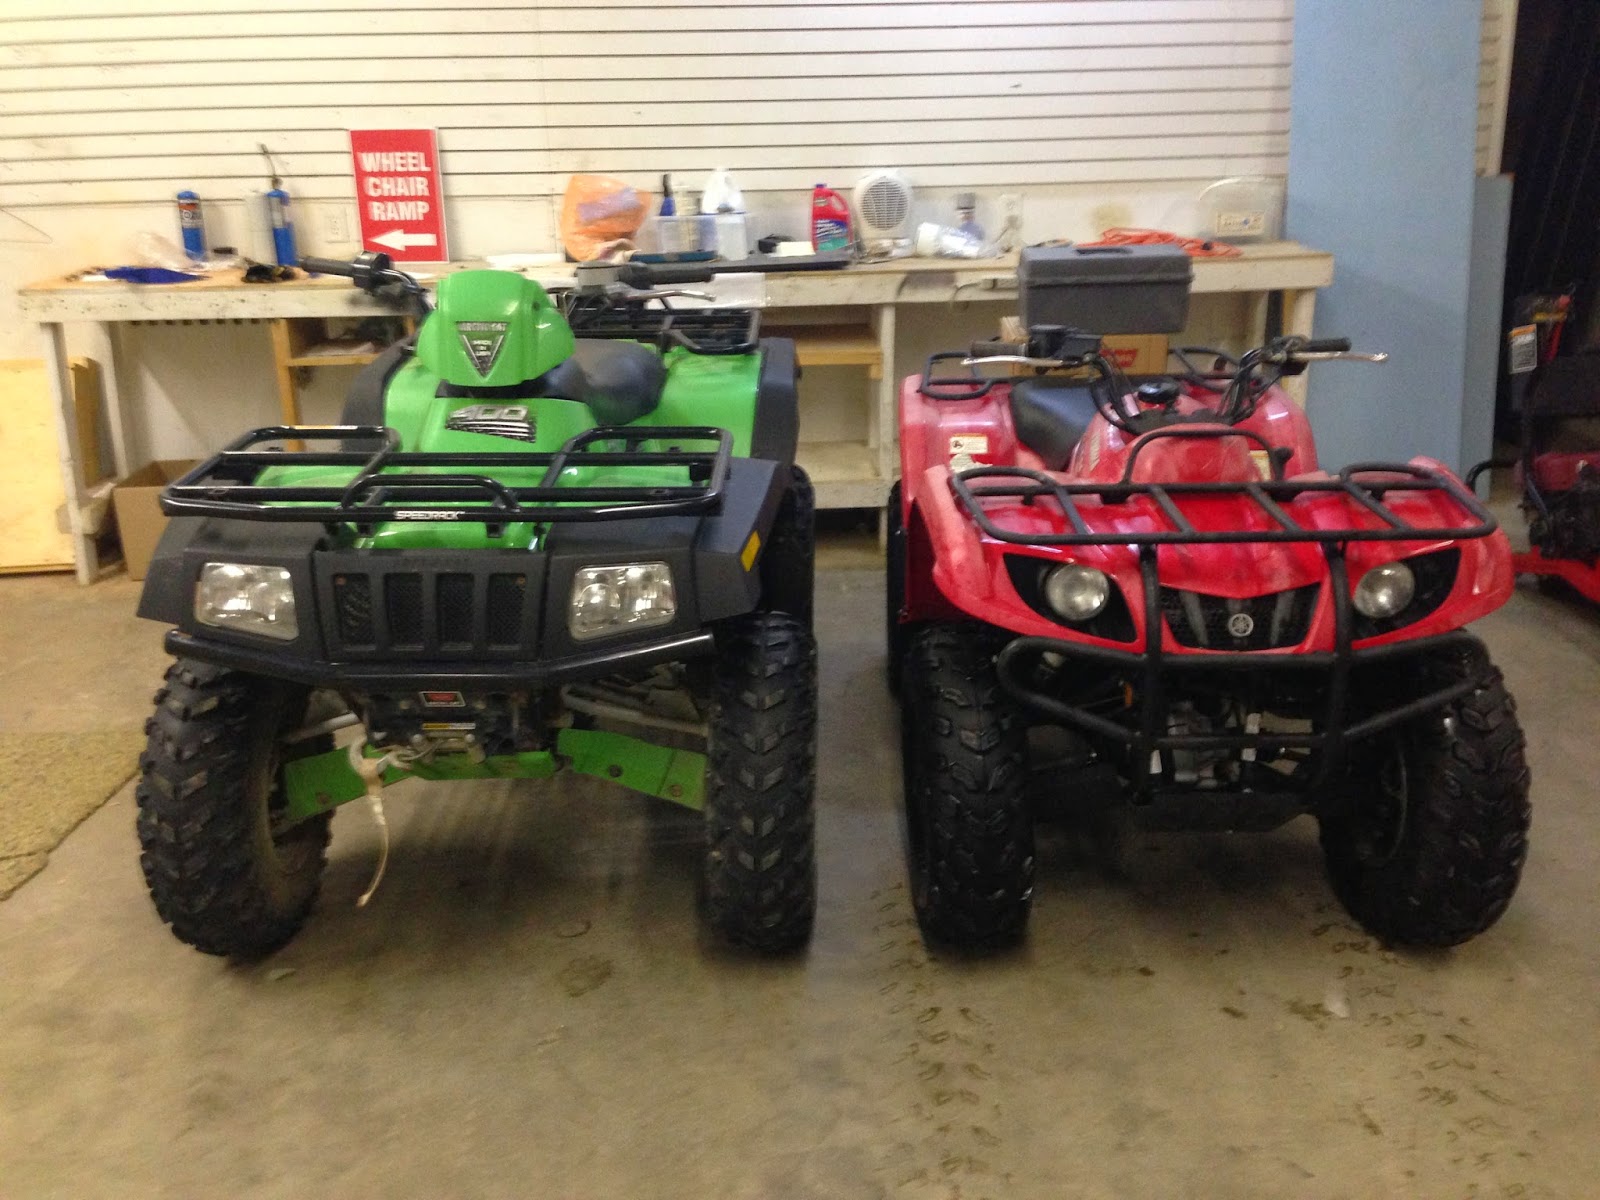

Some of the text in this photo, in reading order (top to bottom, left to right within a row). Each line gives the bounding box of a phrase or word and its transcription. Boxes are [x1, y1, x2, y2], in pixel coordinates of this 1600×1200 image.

[357, 151, 431, 172] WHEEL
[364, 176, 430, 197] CHAIR
[368, 200, 430, 221] RAMP
[448, 404, 529, 421] 400
